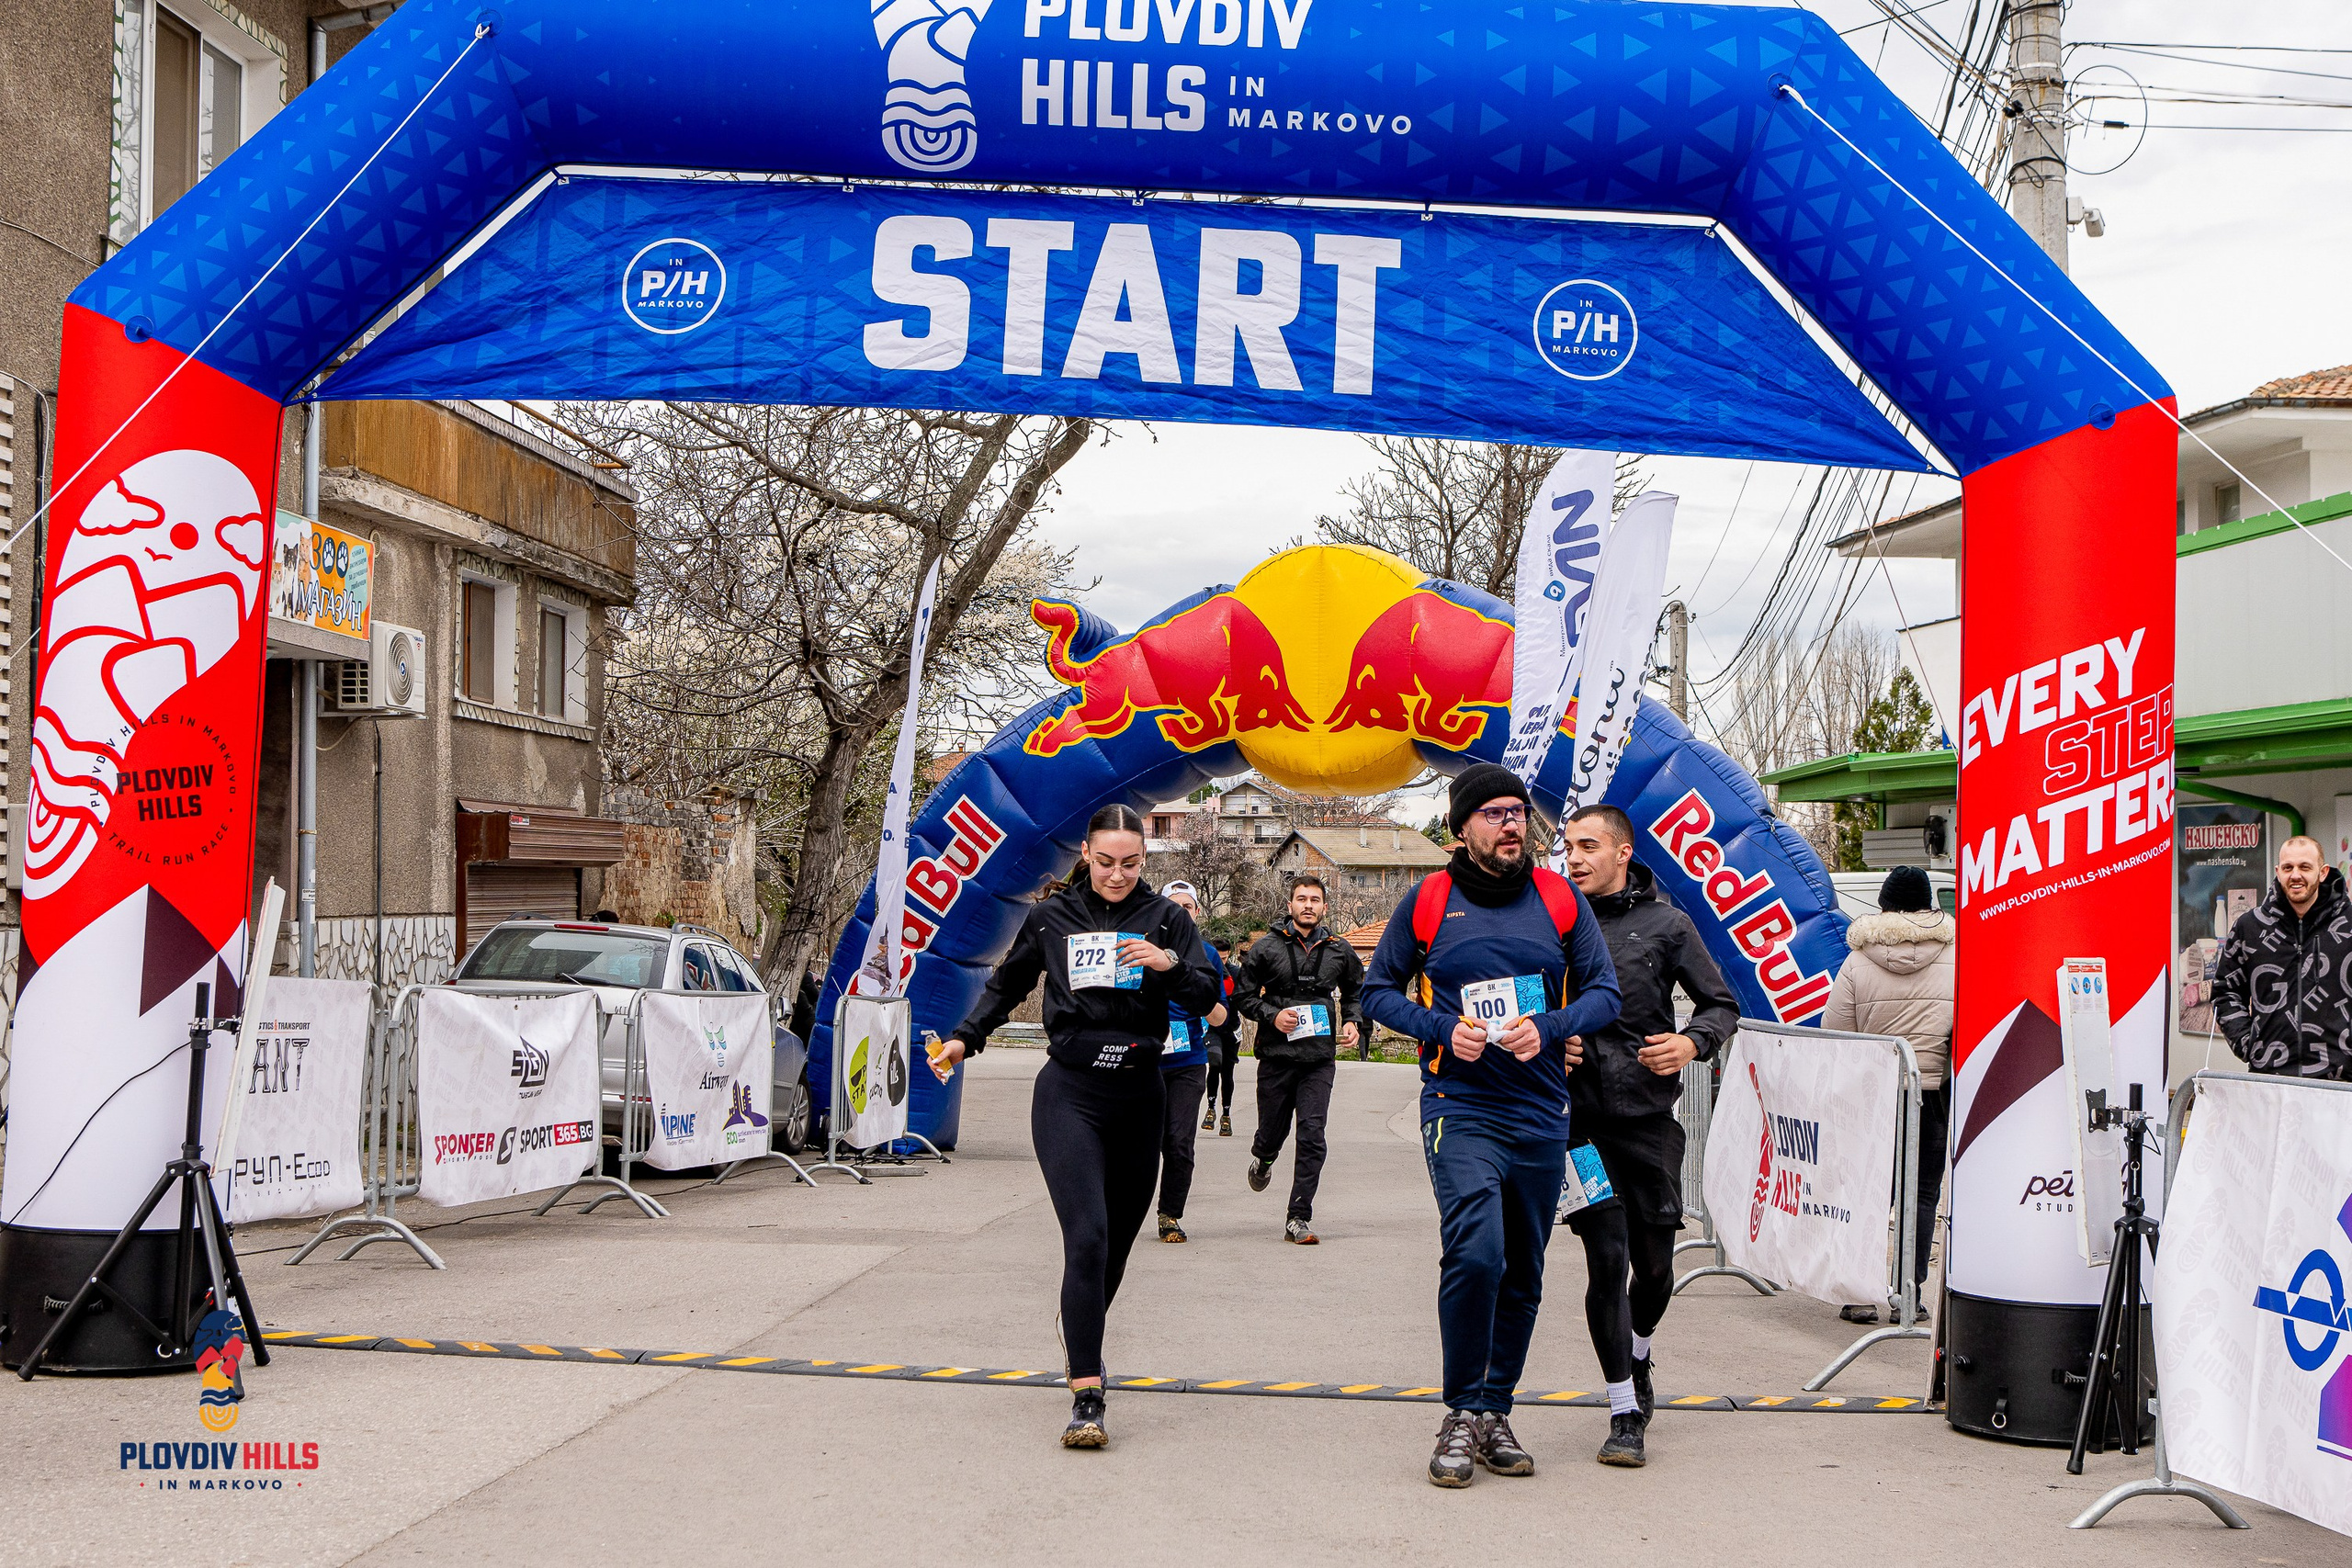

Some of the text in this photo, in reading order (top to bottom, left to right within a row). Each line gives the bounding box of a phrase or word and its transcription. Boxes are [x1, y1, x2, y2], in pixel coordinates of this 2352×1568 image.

[1023, 0, 1313, 50] PLOVDIV
[1022, 58, 1205, 131] HILLS
[1229, 76, 1264, 97] IN
[1228, 107, 1412, 135] MARKOVO
[669, 258, 683, 266] IN
[640, 270, 709, 299] P/H
[638, 300, 704, 309] MARKOVO
[863, 215, 1401, 396] START
[1579, 299, 1593, 308] IN
[1553, 310, 1619, 344] P/H
[1552, 344, 1618, 357] MARKOVO
[298, 581, 362, 631] МАГАЗИН
[1962, 626, 2146, 770] EVERY
[2043, 682, 2174, 796] STEP
[119, 714, 169, 737] HILLS
[179, 715, 196, 728] IN
[202, 725, 236, 795] MARKOVO
[116, 764, 213, 795] PLOVDIV
[138, 795, 202, 822] HILLS
[108, 823, 229, 865] TRAIL RUN RACE
[2184, 823, 2260, 850] НАШЕНСКО
[905, 797, 1003, 915] Bull
[2196, 855, 2247, 867] www.nashensko.bg
[1979, 837, 2171, 921] WWW.PLOVDIV-HILLS-IN-MARKOVO.COM
[1651, 792, 1834, 1025] Red Bull
[1075, 948, 1106, 967] 272
[1472, 998, 1506, 1020] 100
[277, 1021, 311, 1031] TRANSPORT
[1098, 1054, 1123, 1062] RESS
[1102, 1044, 1129, 1054] COMP
[435, 1132, 495, 1166] SPONSER
[1768, 1111, 1819, 1166] OVDIV
[1803, 1181, 1812, 1196] IN
[2036, 1202, 2074, 1213] STUD
